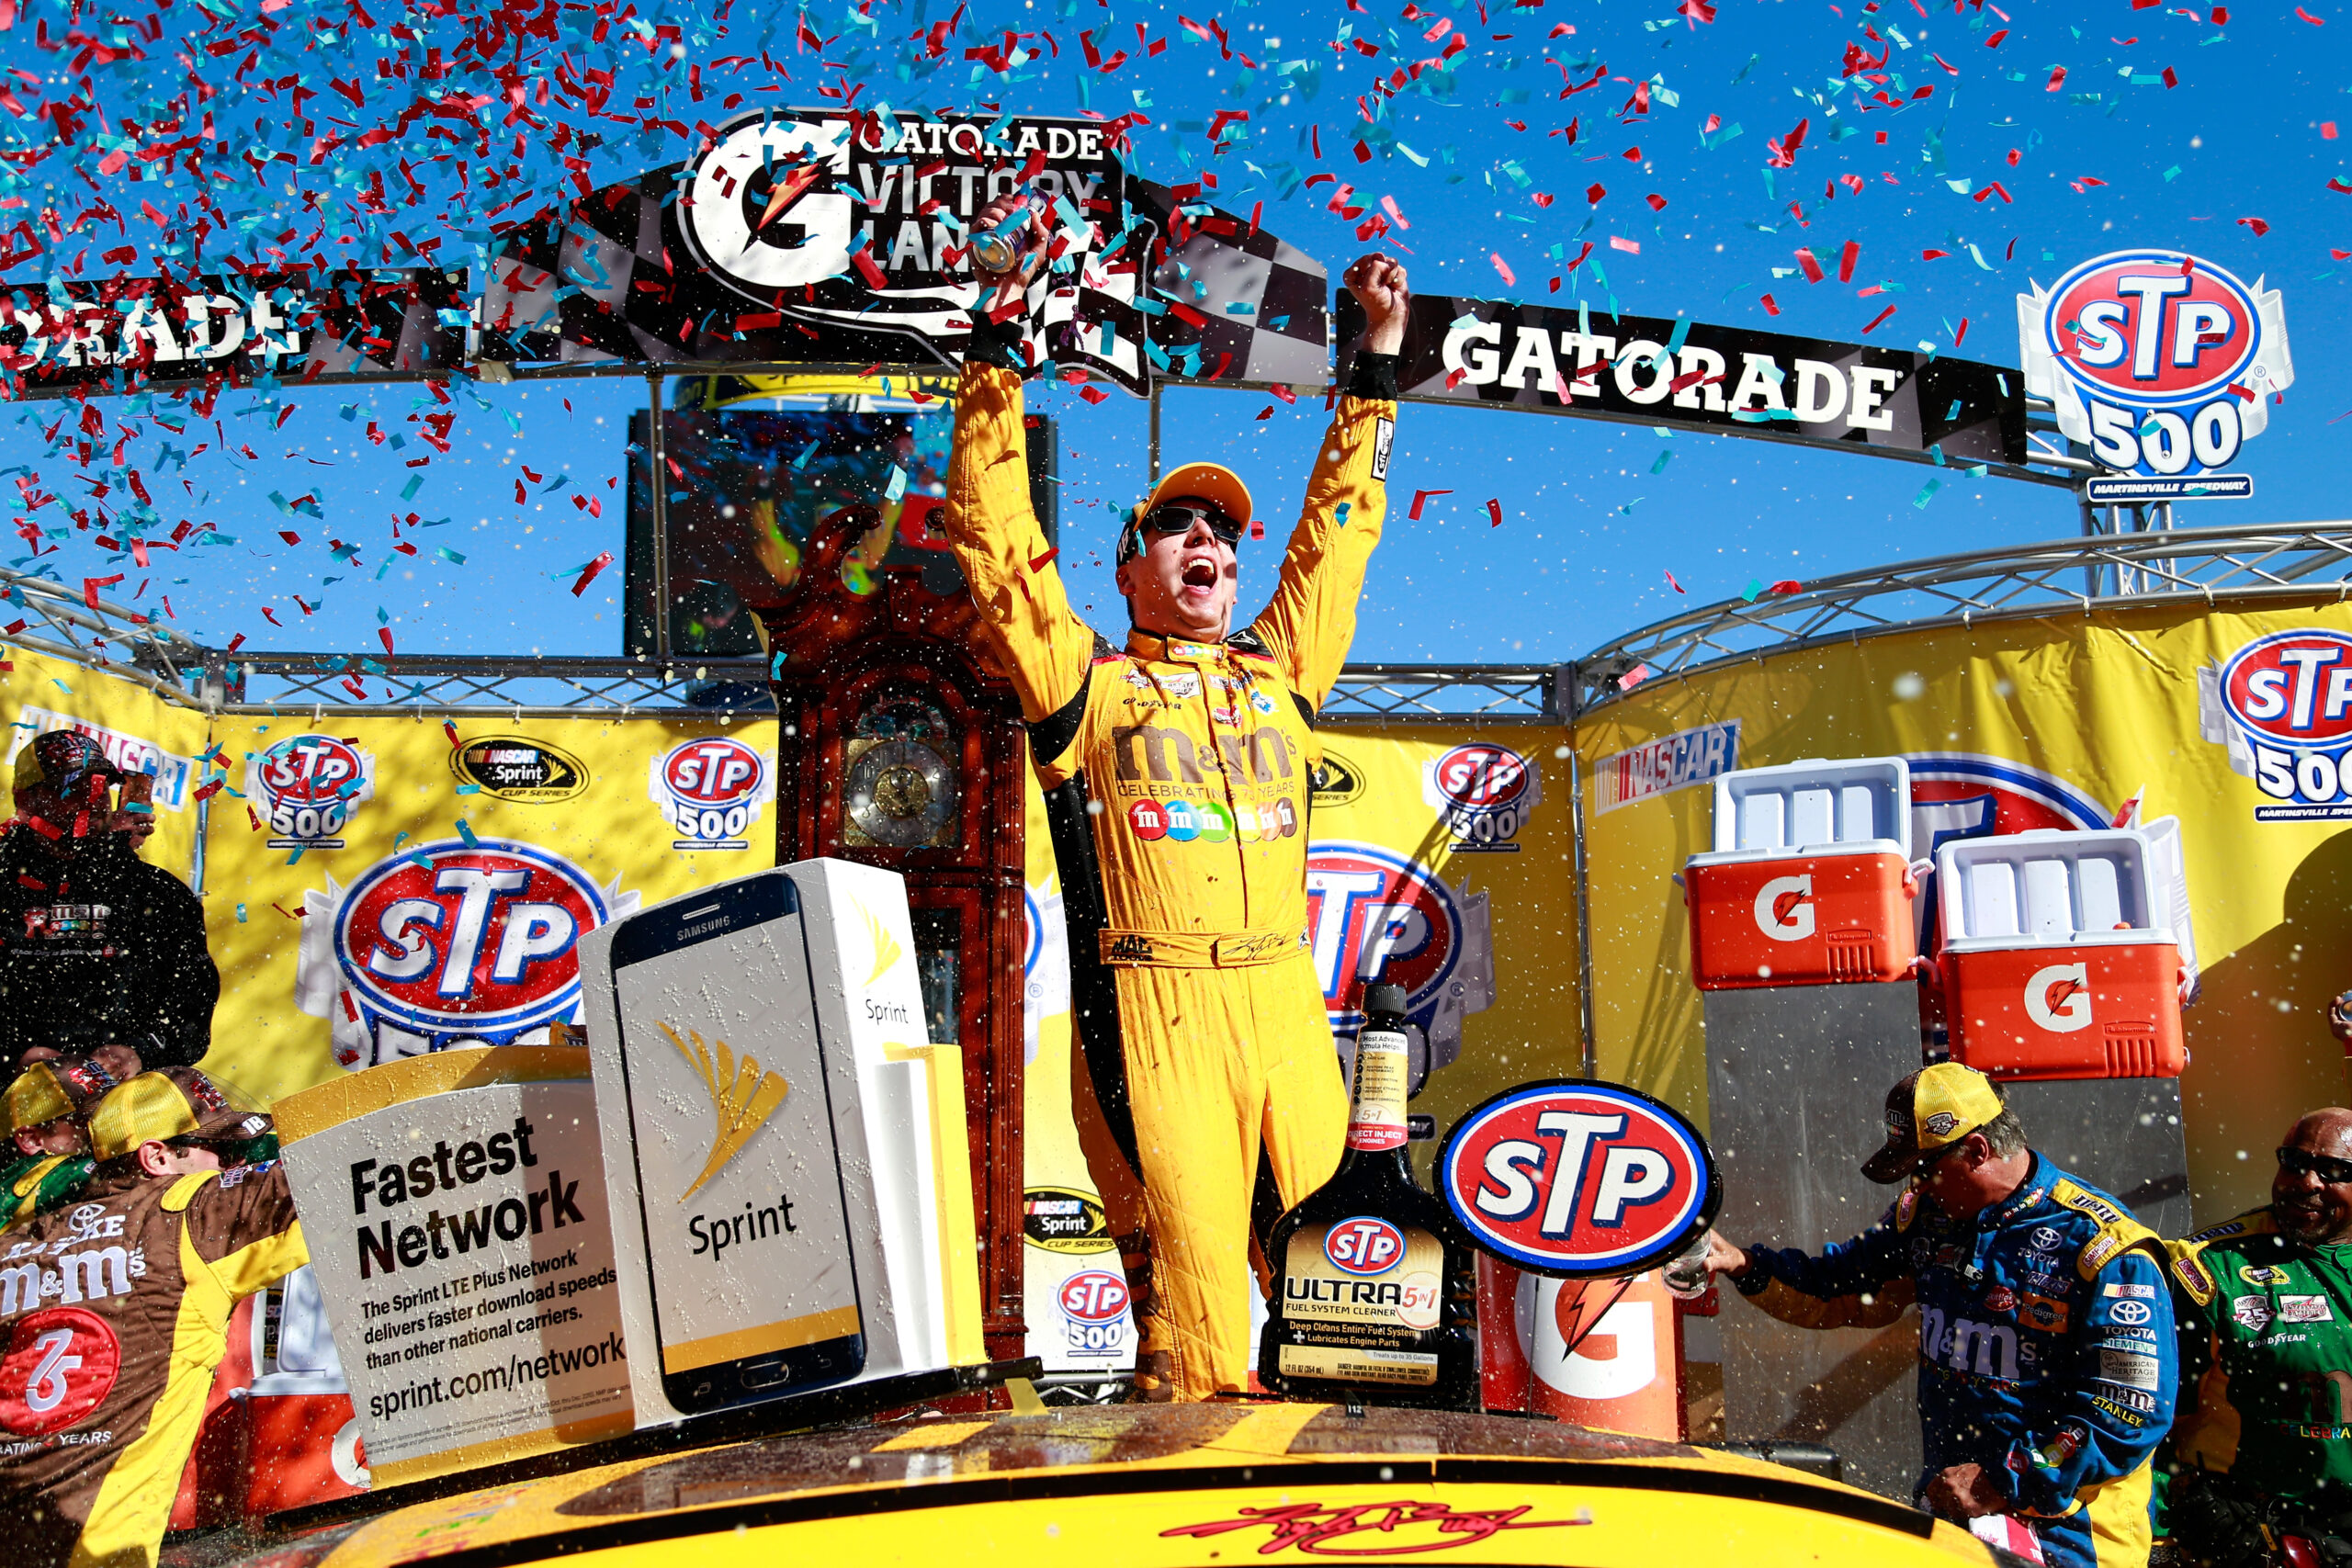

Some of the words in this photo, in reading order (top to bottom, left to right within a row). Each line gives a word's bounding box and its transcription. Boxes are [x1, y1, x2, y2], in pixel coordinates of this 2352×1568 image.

[862, 220, 970, 273] LAN
[2076, 276, 2236, 379] STP
[1442, 321, 1896, 431] GATORADE
[2090, 399, 2242, 475] 500
[2094, 483, 2180, 494] MARTINSVILLE
[270, 746, 350, 795] STP
[489, 750, 538, 763] NASCAR
[1627, 733, 1728, 799] NASCAR
[496, 765, 543, 783] Sprint
[674, 748, 752, 796] STP
[1446, 753, 1519, 800] STP
[1258, 781, 1295, 798] YEARS
[272, 805, 346, 838] 500
[676, 803, 748, 840] 500
[1451, 807, 1519, 842] 500
[2258, 807, 2330, 818] MARTINSVILLE
[369, 869, 578, 999] STP
[676, 916, 730, 942] SAMSUNG
[1306, 869, 1433, 998] TP
[1111, 934, 1153, 954] MAC
[865, 998, 908, 1024] Sprint
[1374, 1130, 1403, 1140] INJECT
[350, 1116, 537, 1215] Fastest
[1474, 1110, 1676, 1241] STP
[1034, 1201, 1081, 1214] NASCAR
[356, 1169, 585, 1280] Network
[688, 1195, 797, 1262] Sprint
[1041, 1217, 1087, 1235] Sprint
[1333, 1224, 1396, 1267] STP
[2019, 1247, 2060, 1268] TOYOTA
[2084, 1238, 2113, 1267] SIMPSON
[361, 1299, 390, 1319] The
[392, 1285, 441, 1314] Sprint
[442, 1277, 470, 1298] LTE
[473, 1270, 506, 1292] Plus
[508, 1249, 579, 1282] Network
[2179, 1259, 2207, 1291] SIMPSON
[1066, 1277, 1125, 1316] STP
[1286, 1277, 1402, 1305] ULTRA
[364, 1314, 426, 1345] delivers
[428, 1304, 473, 1330] faster
[476, 1280, 555, 1317] download
[558, 1268, 617, 1298] speeds
[1285, 1303, 1309, 1312] FUEL
[1311, 1304, 1350, 1314] SYSTEM
[1352, 1306, 1396, 1317] CLEANER
[2239, 1308, 2268, 1323] 25
[366, 1350, 401, 1371] than
[404, 1336, 446, 1361] other
[448, 1324, 513, 1350] national
[515, 1305, 583, 1334] carriers.
[1069, 1321, 1123, 1349] 500
[1289, 1321, 1312, 1332] Deep
[1313, 1322, 1340, 1332] Cleans
[1341, 1325, 1366, 1334] Entire
[1367, 1325, 1385, 1336] Fuel
[1386, 1326, 1418, 1337] System
[1307, 1334, 1349, 1344] Lubricates
[1350, 1337, 1376, 1348] Engine
[1378, 1338, 1400, 1348] Parts
[2102, 1325, 2157, 1341] TOYOTA
[2247, 1332, 2307, 1348] GOODYEAR
[2103, 1337, 2156, 1354] SIEMENS
[370, 1332, 626, 1421] sprint.com/network
[2111, 1367, 2155, 1376] HERITAGE
[2118, 1359, 2155, 1369] AMERICAN
[1971, 1375, 2020, 1393] YARS
[2092, 1396, 2144, 1427] STANLEY
[58, 1430, 113, 1447] YEARS
